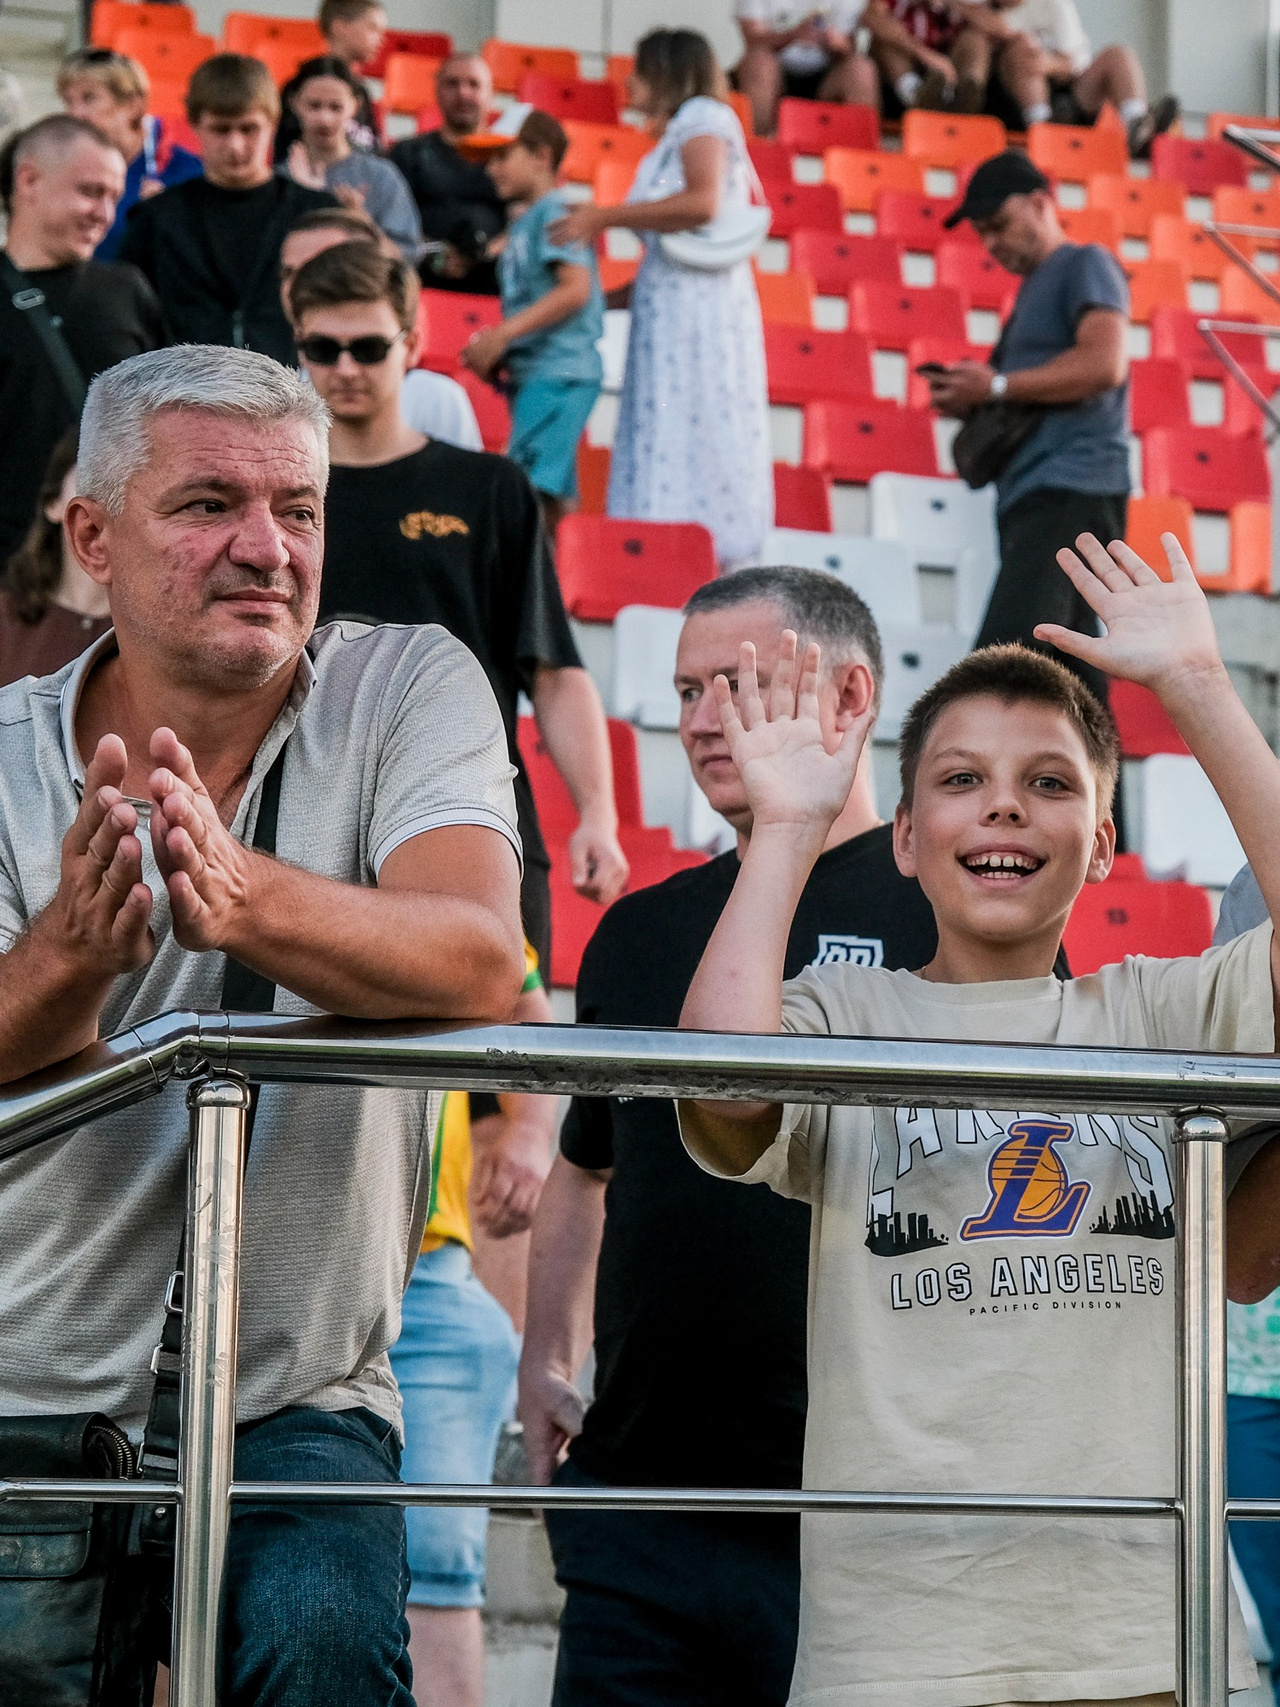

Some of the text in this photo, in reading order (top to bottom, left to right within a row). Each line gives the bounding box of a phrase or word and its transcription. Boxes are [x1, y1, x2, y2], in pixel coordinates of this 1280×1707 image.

[890, 1253, 1164, 1310] LOS ANGELES
[969, 1301, 1122, 1316] PACIFIC DIVISION
